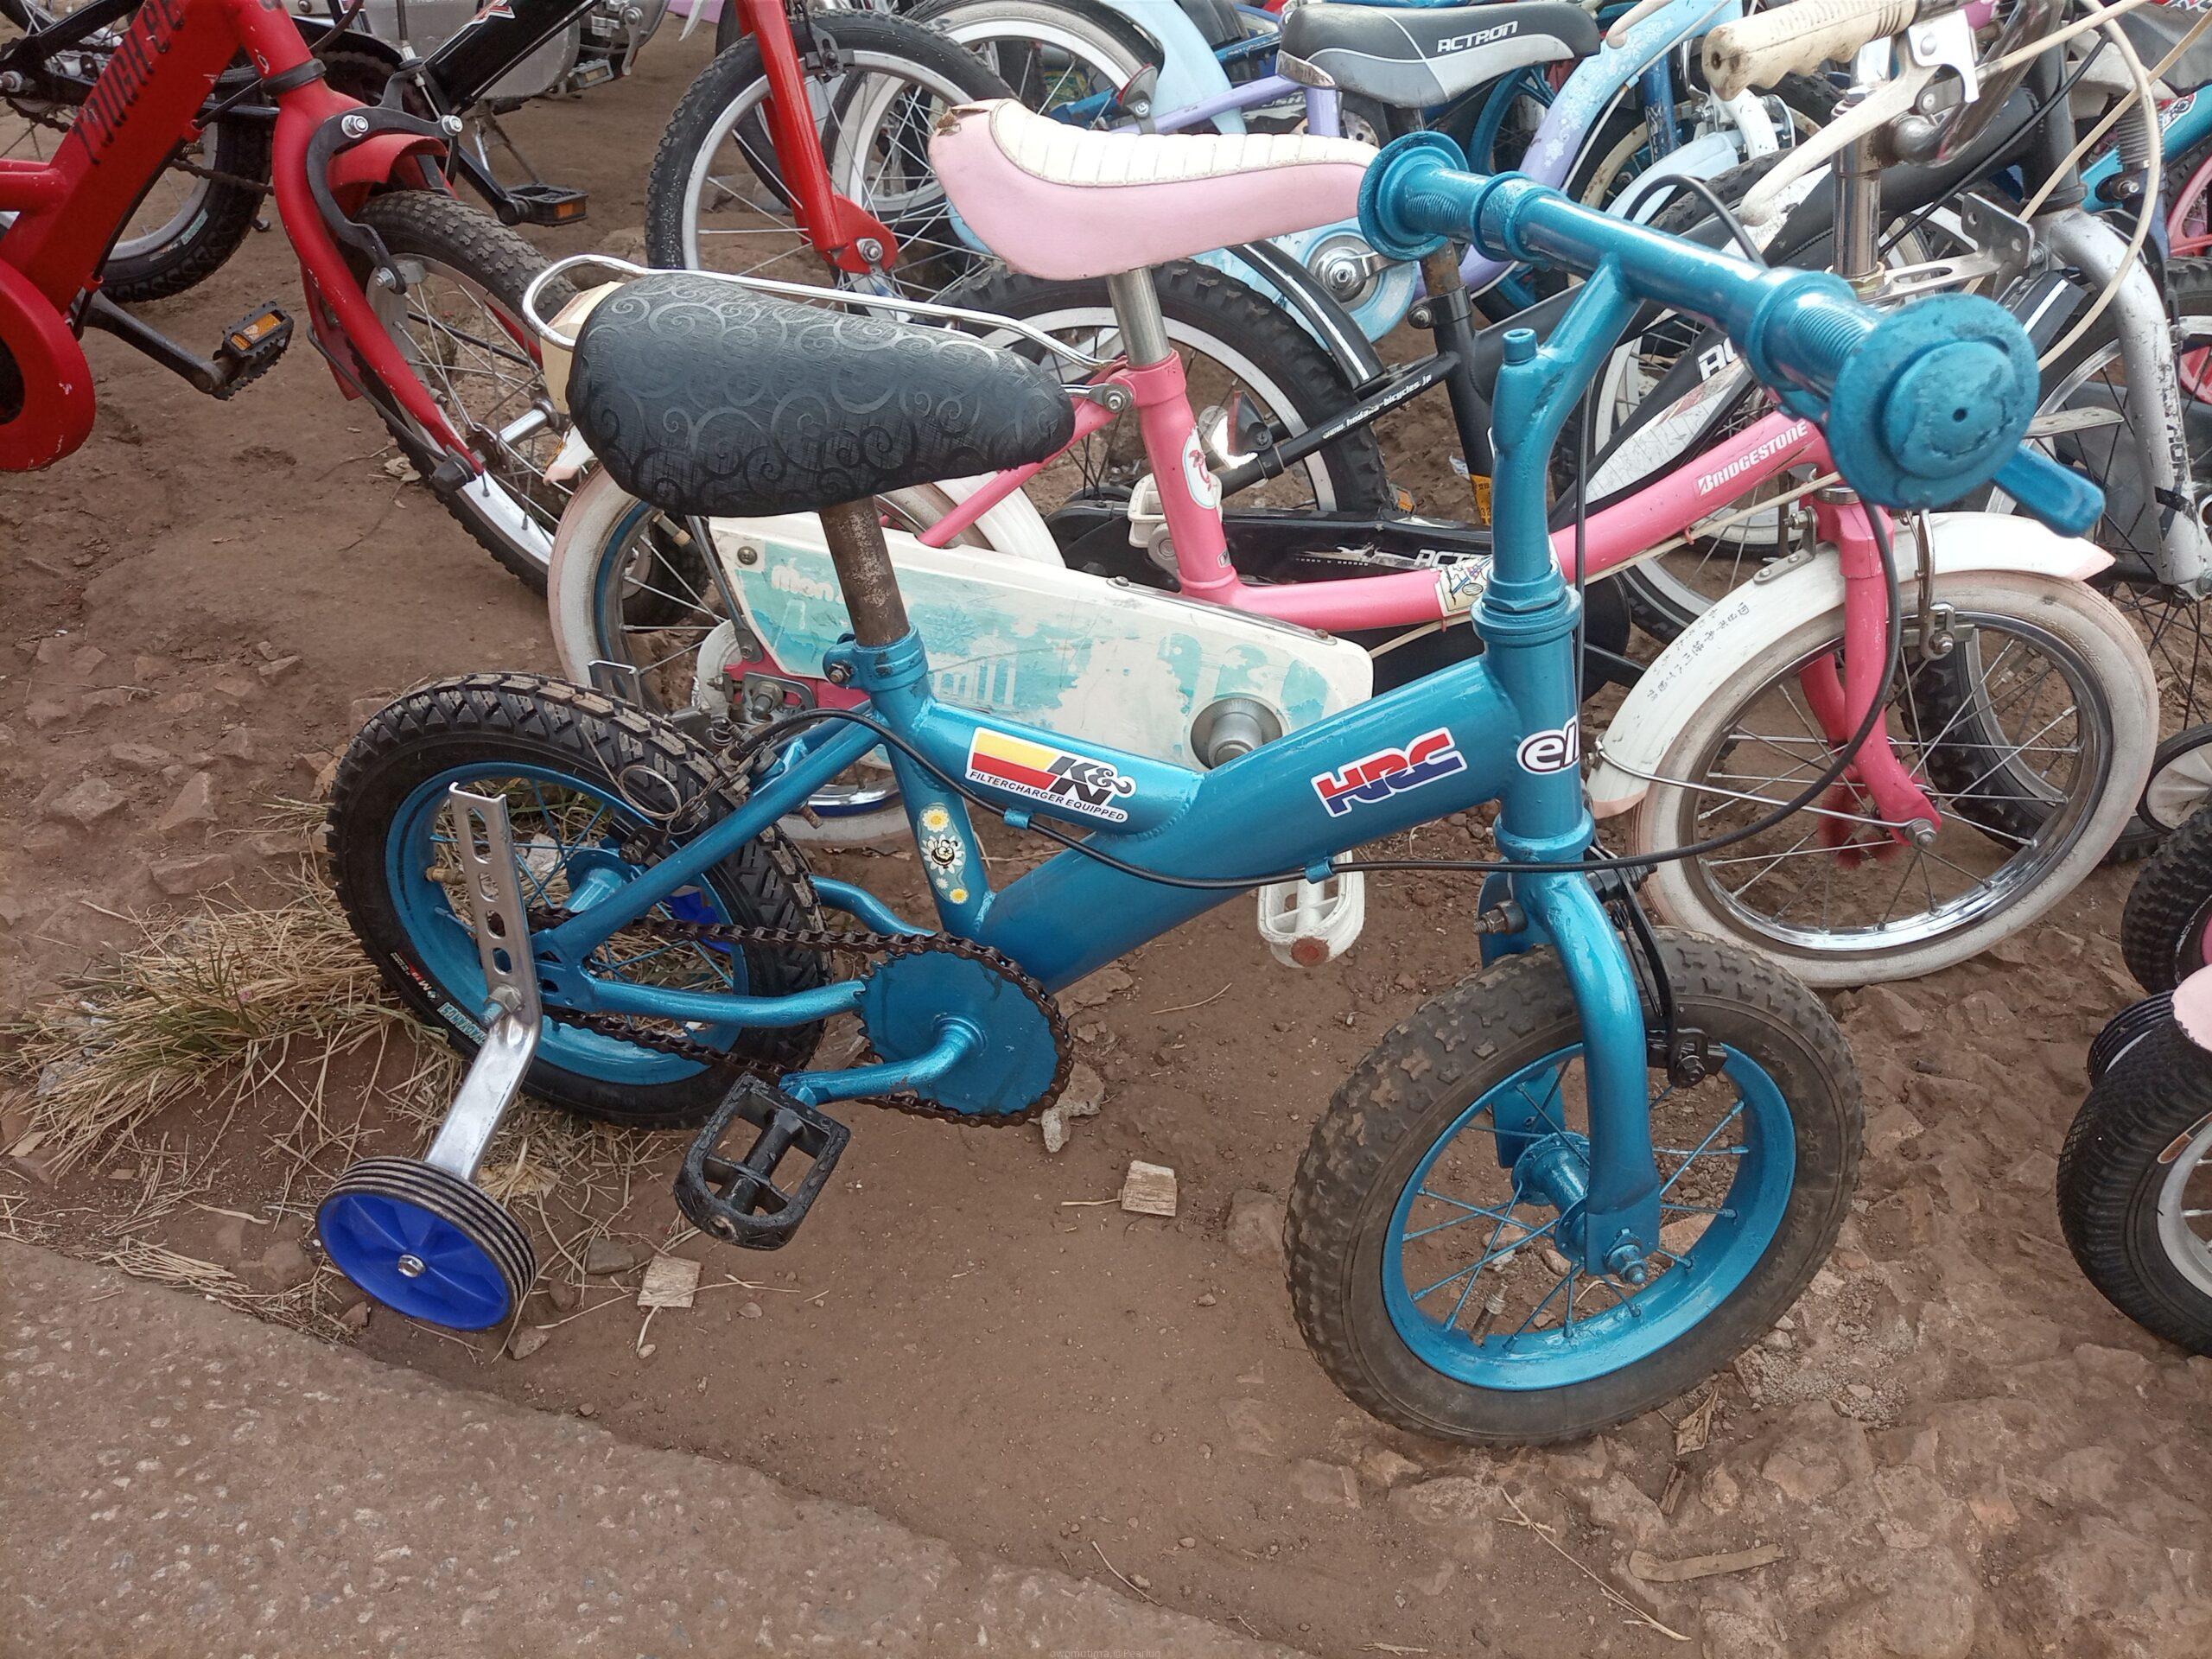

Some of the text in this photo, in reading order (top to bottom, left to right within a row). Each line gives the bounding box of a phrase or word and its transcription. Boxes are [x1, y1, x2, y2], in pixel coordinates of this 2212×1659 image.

[1437, 21, 1518, 53] ACTRON
[1697, 421, 1808, 497] BRIDGESTONE
[1313, 730, 1466, 816] HRC
[1518, 717, 1580, 774] el
[969, 770, 1124, 821] FILTERCHARGER EQUIPPED
